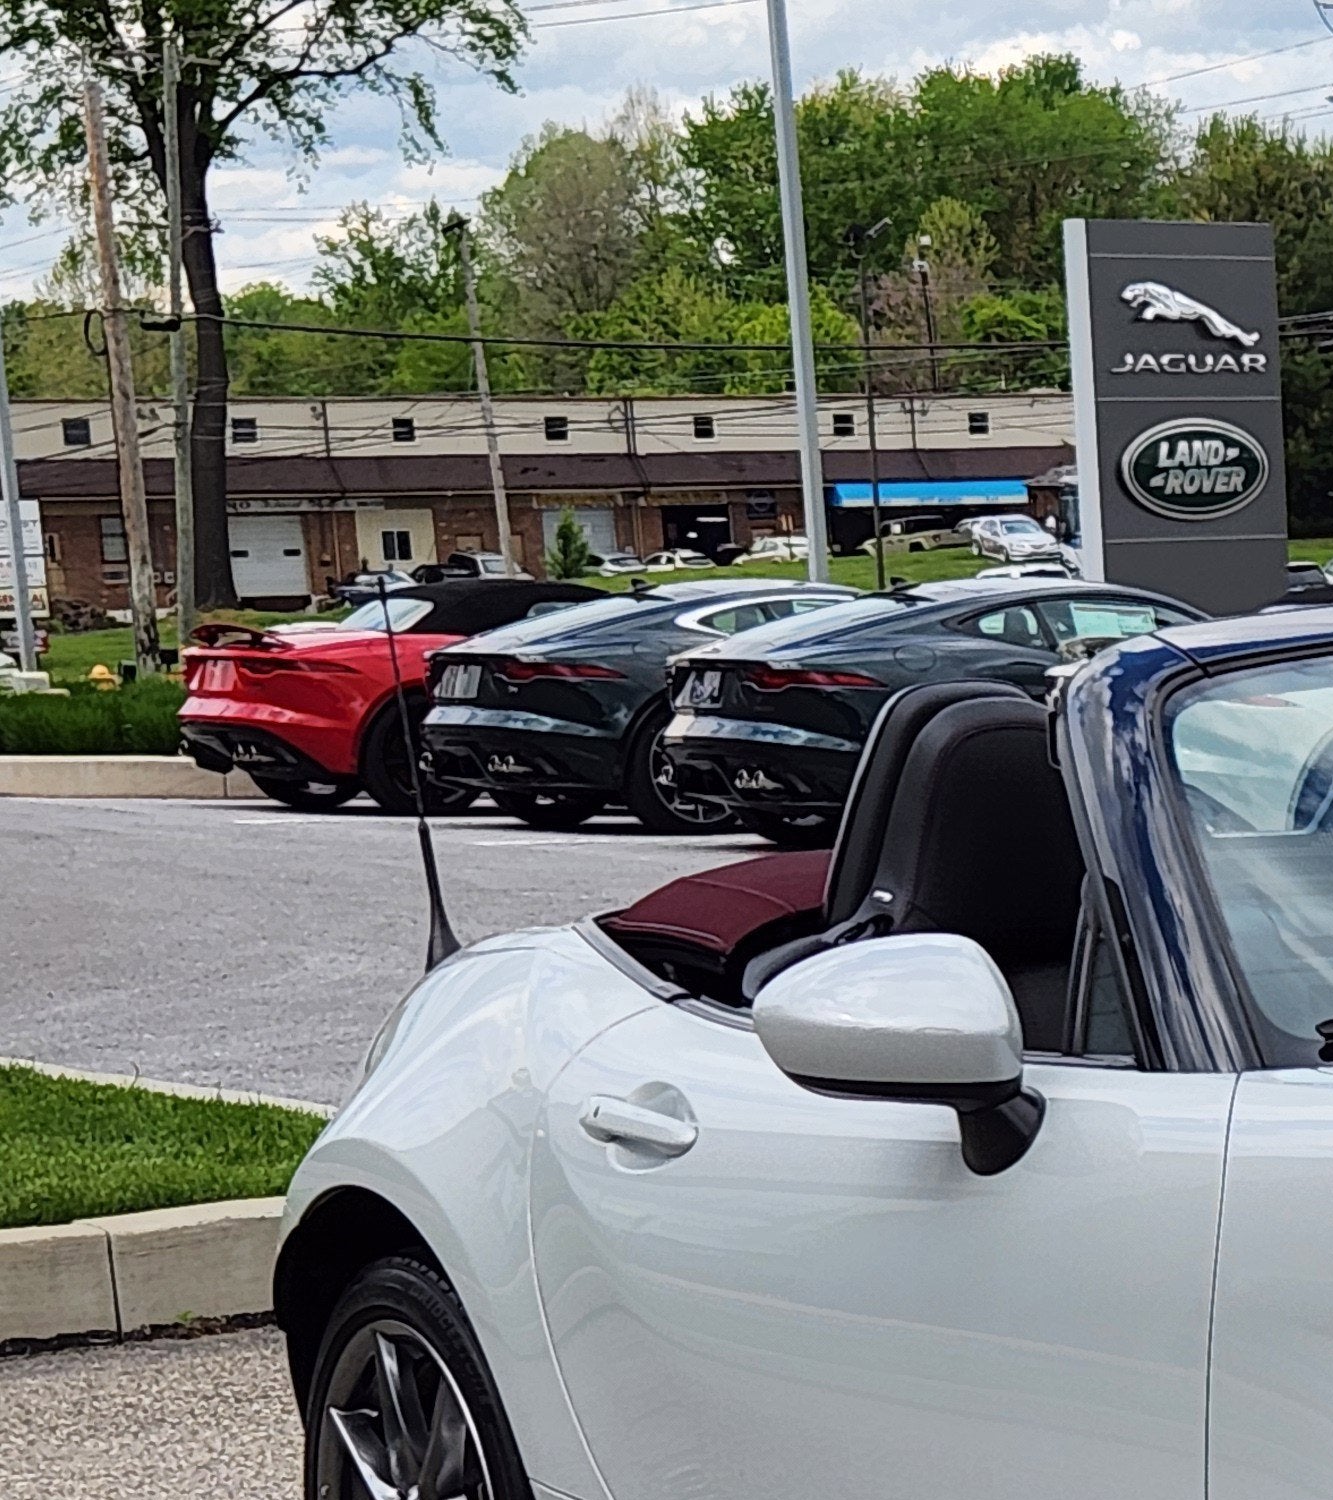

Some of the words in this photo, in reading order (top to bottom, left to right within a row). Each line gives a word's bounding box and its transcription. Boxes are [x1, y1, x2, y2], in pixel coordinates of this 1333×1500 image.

[1110, 352, 1267, 373] JAGUAR
[1158, 440, 1227, 468] LAND
[1164, 467, 1246, 494] ROVER
